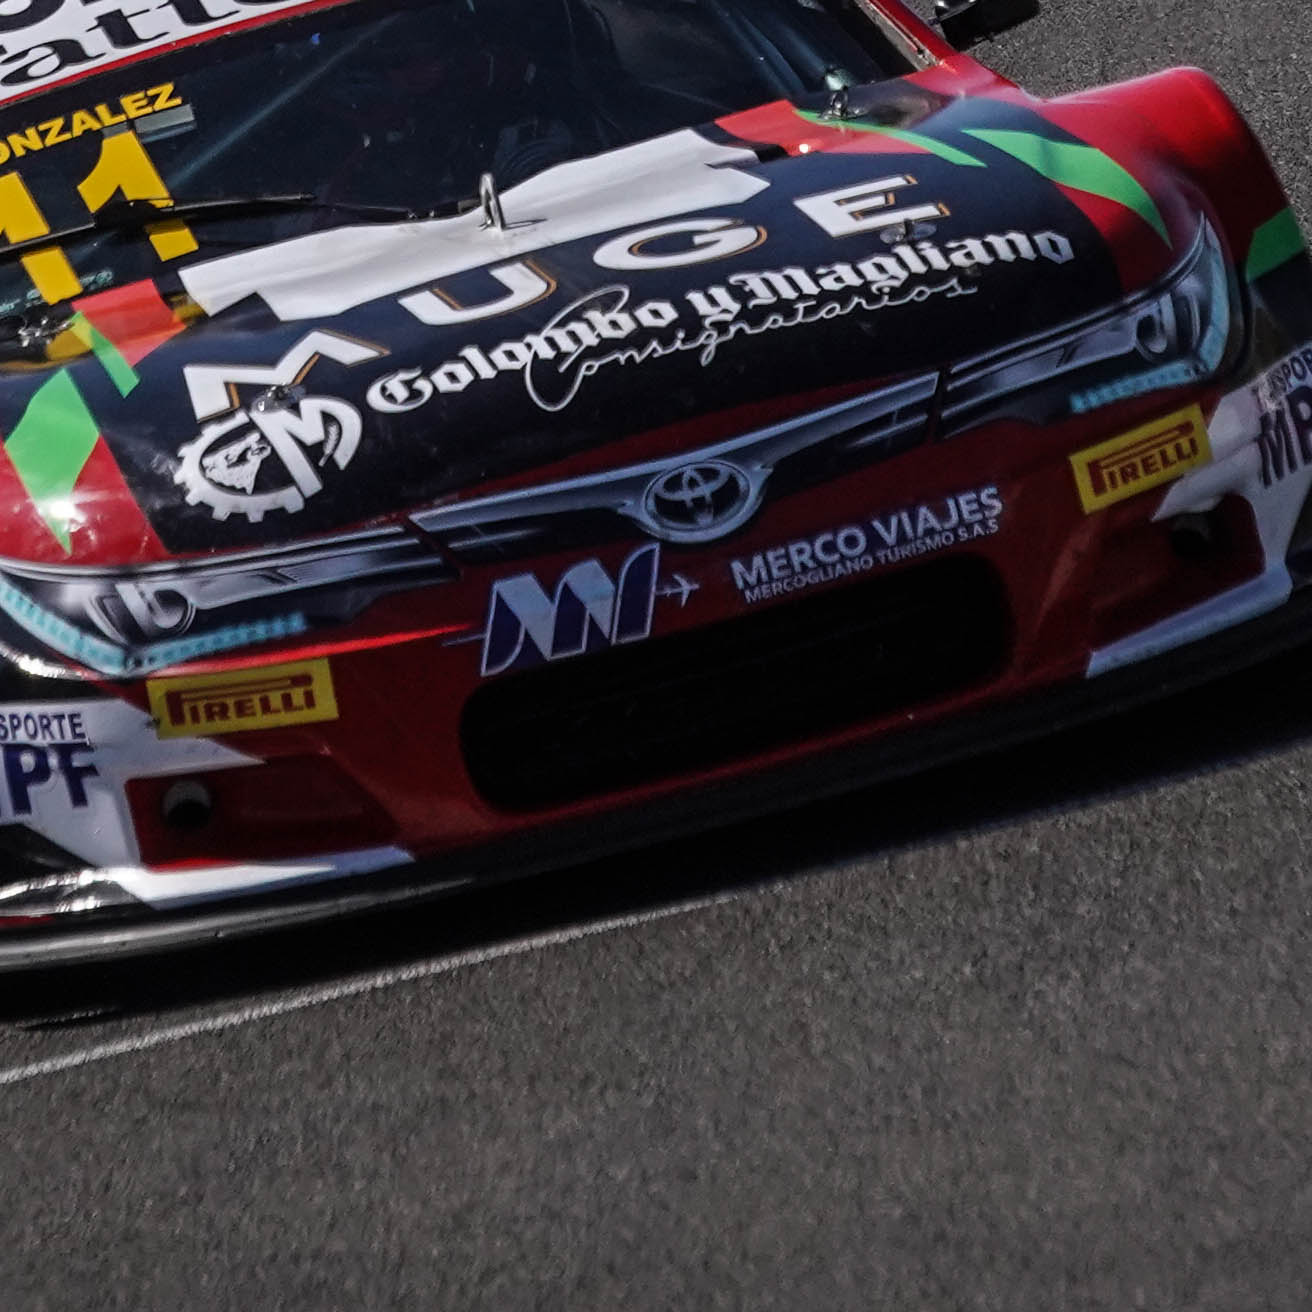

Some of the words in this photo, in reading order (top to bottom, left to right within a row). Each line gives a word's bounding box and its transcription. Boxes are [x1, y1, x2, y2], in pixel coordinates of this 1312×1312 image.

[183, 173, 951, 424] MUGE
[365, 298, 678, 415] Colombo
[728, 228, 1074, 316] Magliano
[523, 285, 978, 413] Consignatarios
[1087, 421, 1200, 498] PIRELLI
[730, 527, 867, 590] MERCO
[871, 485, 1004, 548] VIAJES
[744, 555, 874, 604] MERCOGLIANO
[877, 530, 955, 566] TURISMO
[167, 673, 317, 727] PIRELLI
